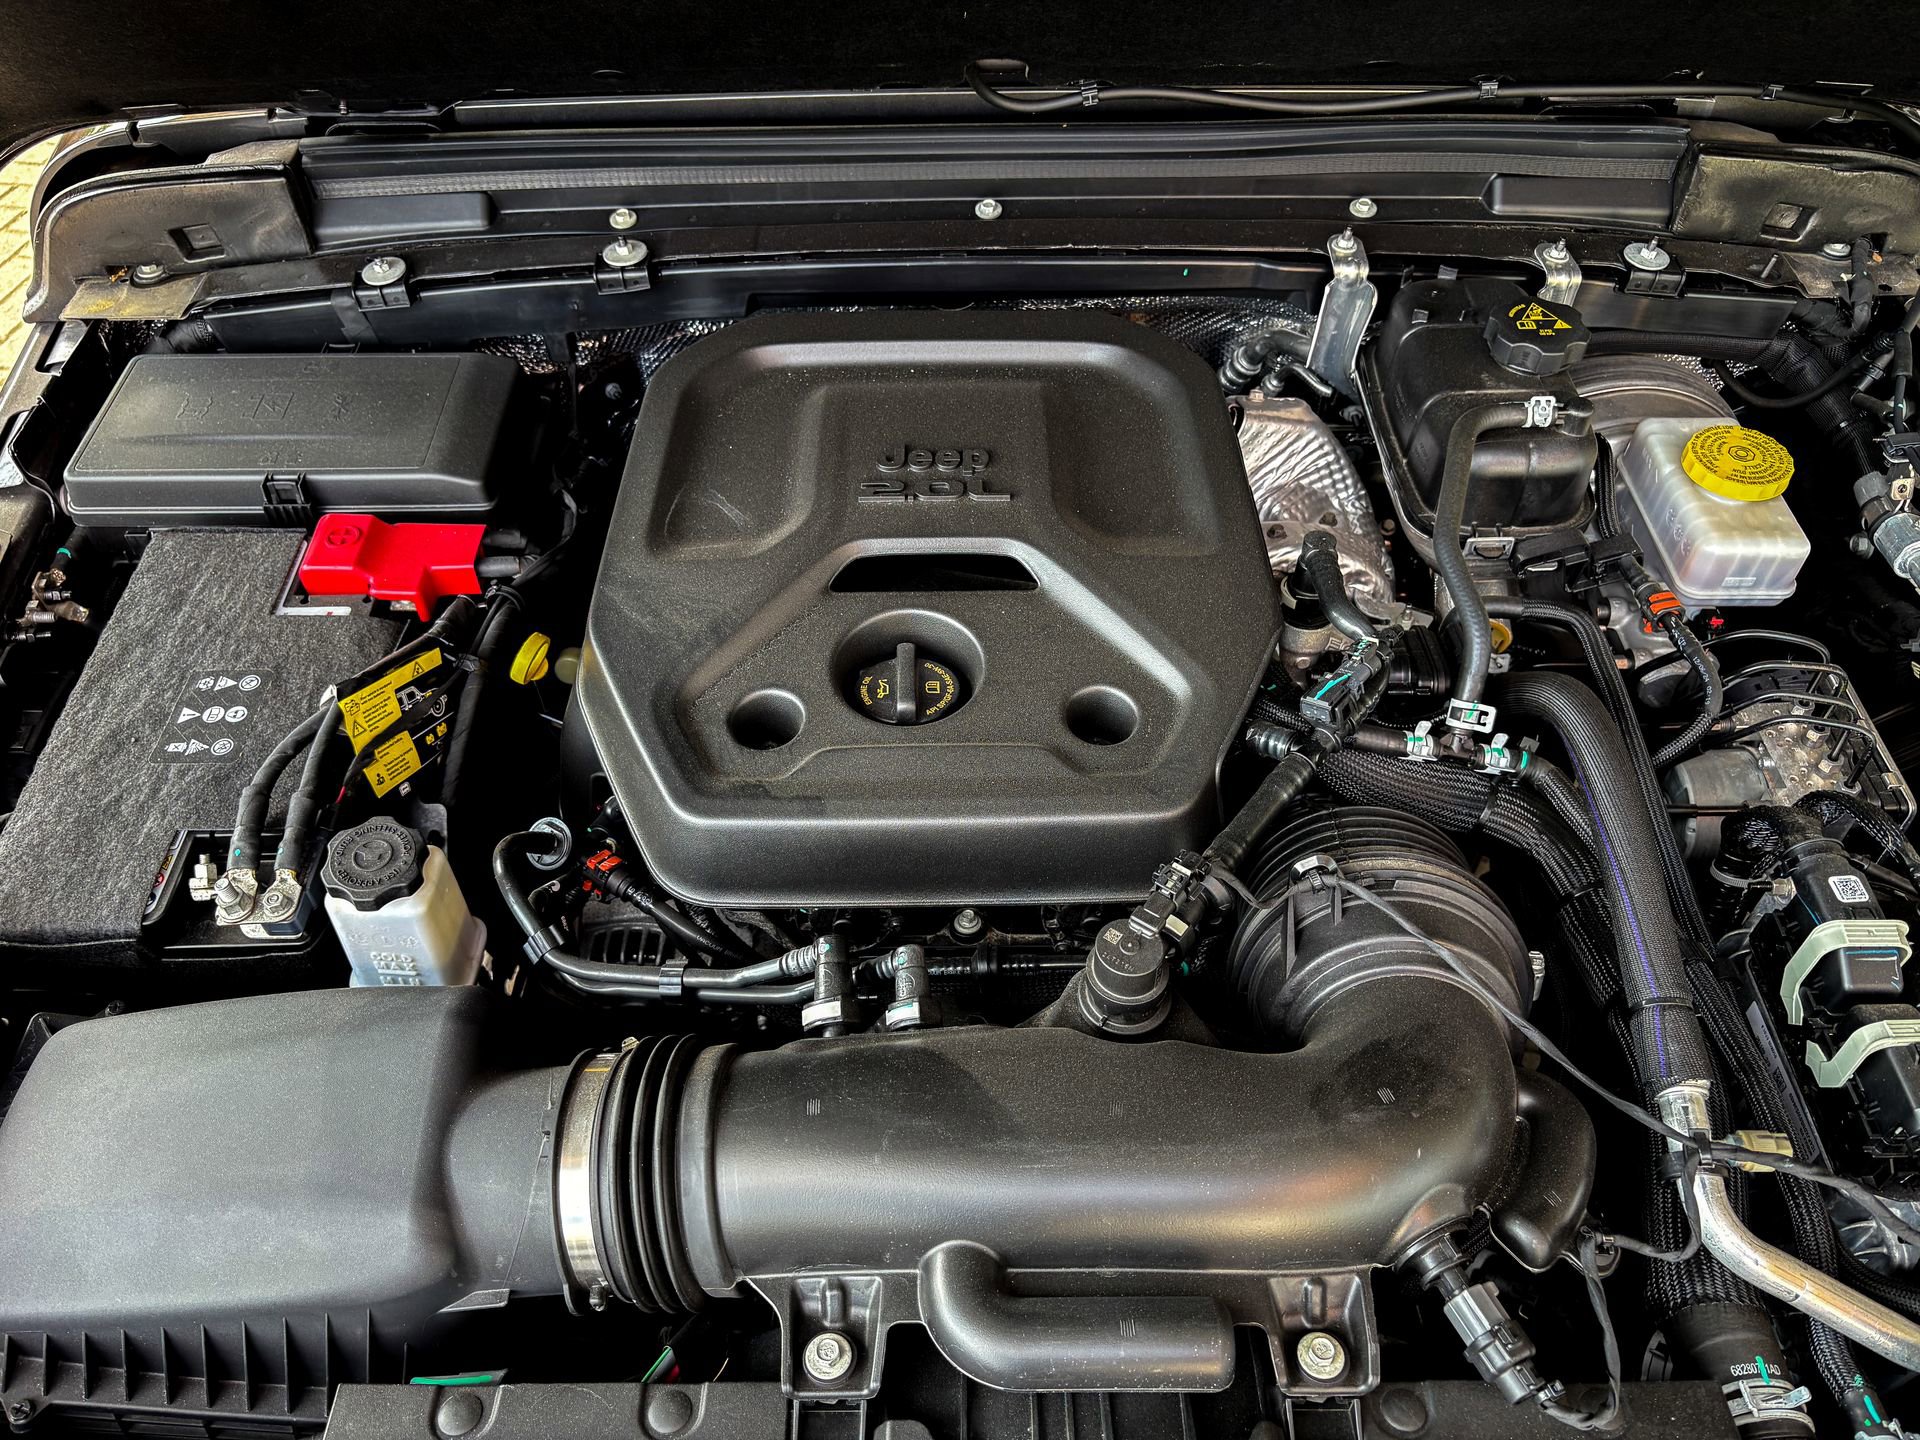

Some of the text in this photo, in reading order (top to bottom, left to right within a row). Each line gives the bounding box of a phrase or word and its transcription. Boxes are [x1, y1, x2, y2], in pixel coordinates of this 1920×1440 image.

[876, 443, 990, 476] Jeep
[858, 479, 1011, 503] 2.0L
[859, 675, 874, 706] ENGINE OIL
[926, 706, 939, 716] API
[333, 824, 412, 857] POWER STEERING FLUID
[336, 867, 401, 887] USE APPROVED
[370, 951, 414, 963] COLD
[373, 961, 417, 971] MAX
[1730, 1362, 1781, 1377] 6828071AD
